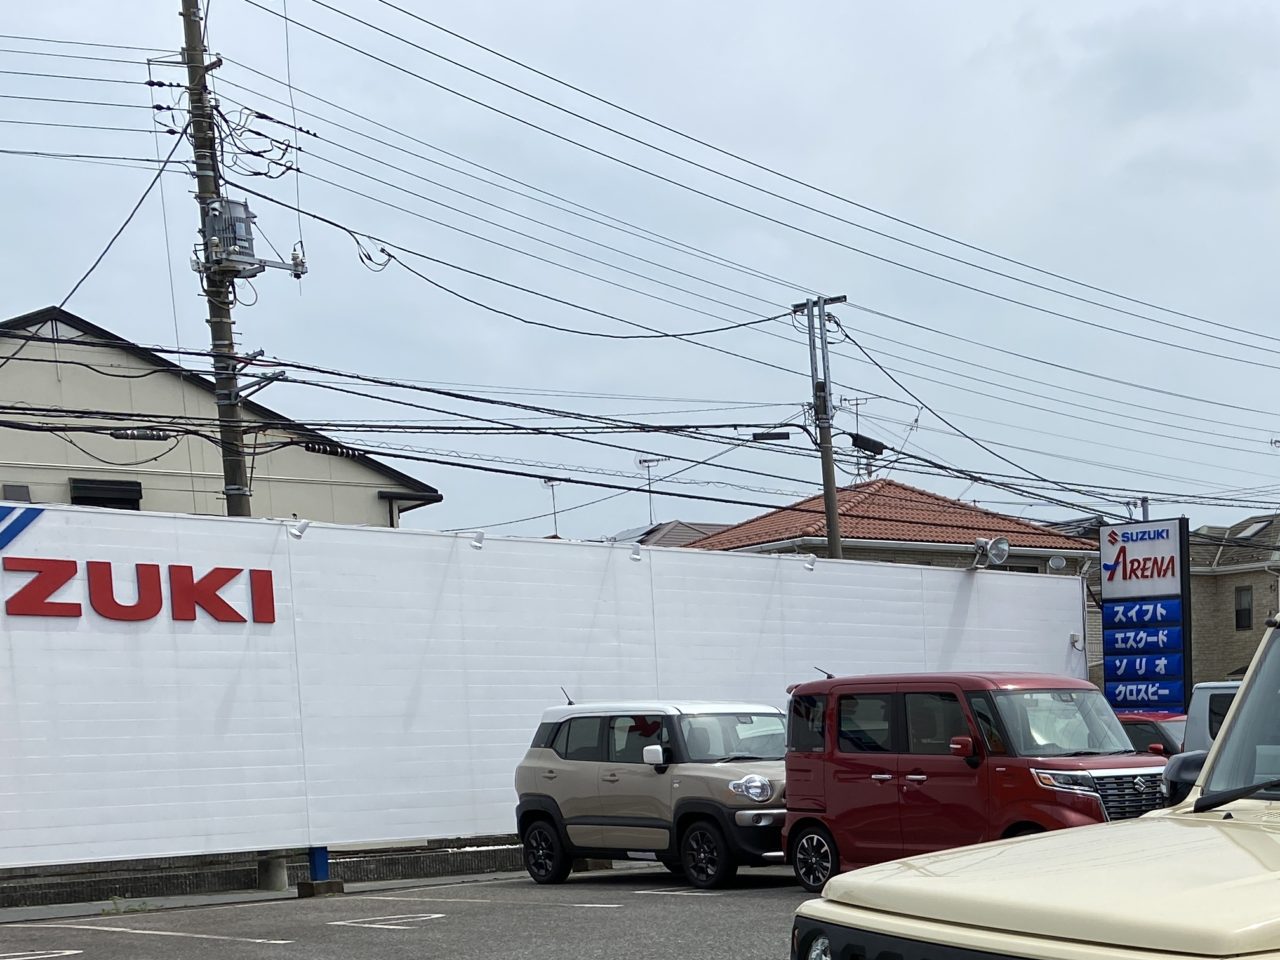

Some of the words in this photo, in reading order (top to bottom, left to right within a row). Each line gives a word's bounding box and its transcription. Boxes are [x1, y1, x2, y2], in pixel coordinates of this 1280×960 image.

[1121, 529, 1170, 543] SUZUKI
[1105, 545, 1175, 582] ARENA
[2, 557, 276, 623] ZUKI
[1114, 603, 1167, 624] スイフト
[1115, 630, 1168, 649] エスクード
[1115, 657, 1168, 675] ソリオ
[1115, 683, 1170, 701] クロスビー
